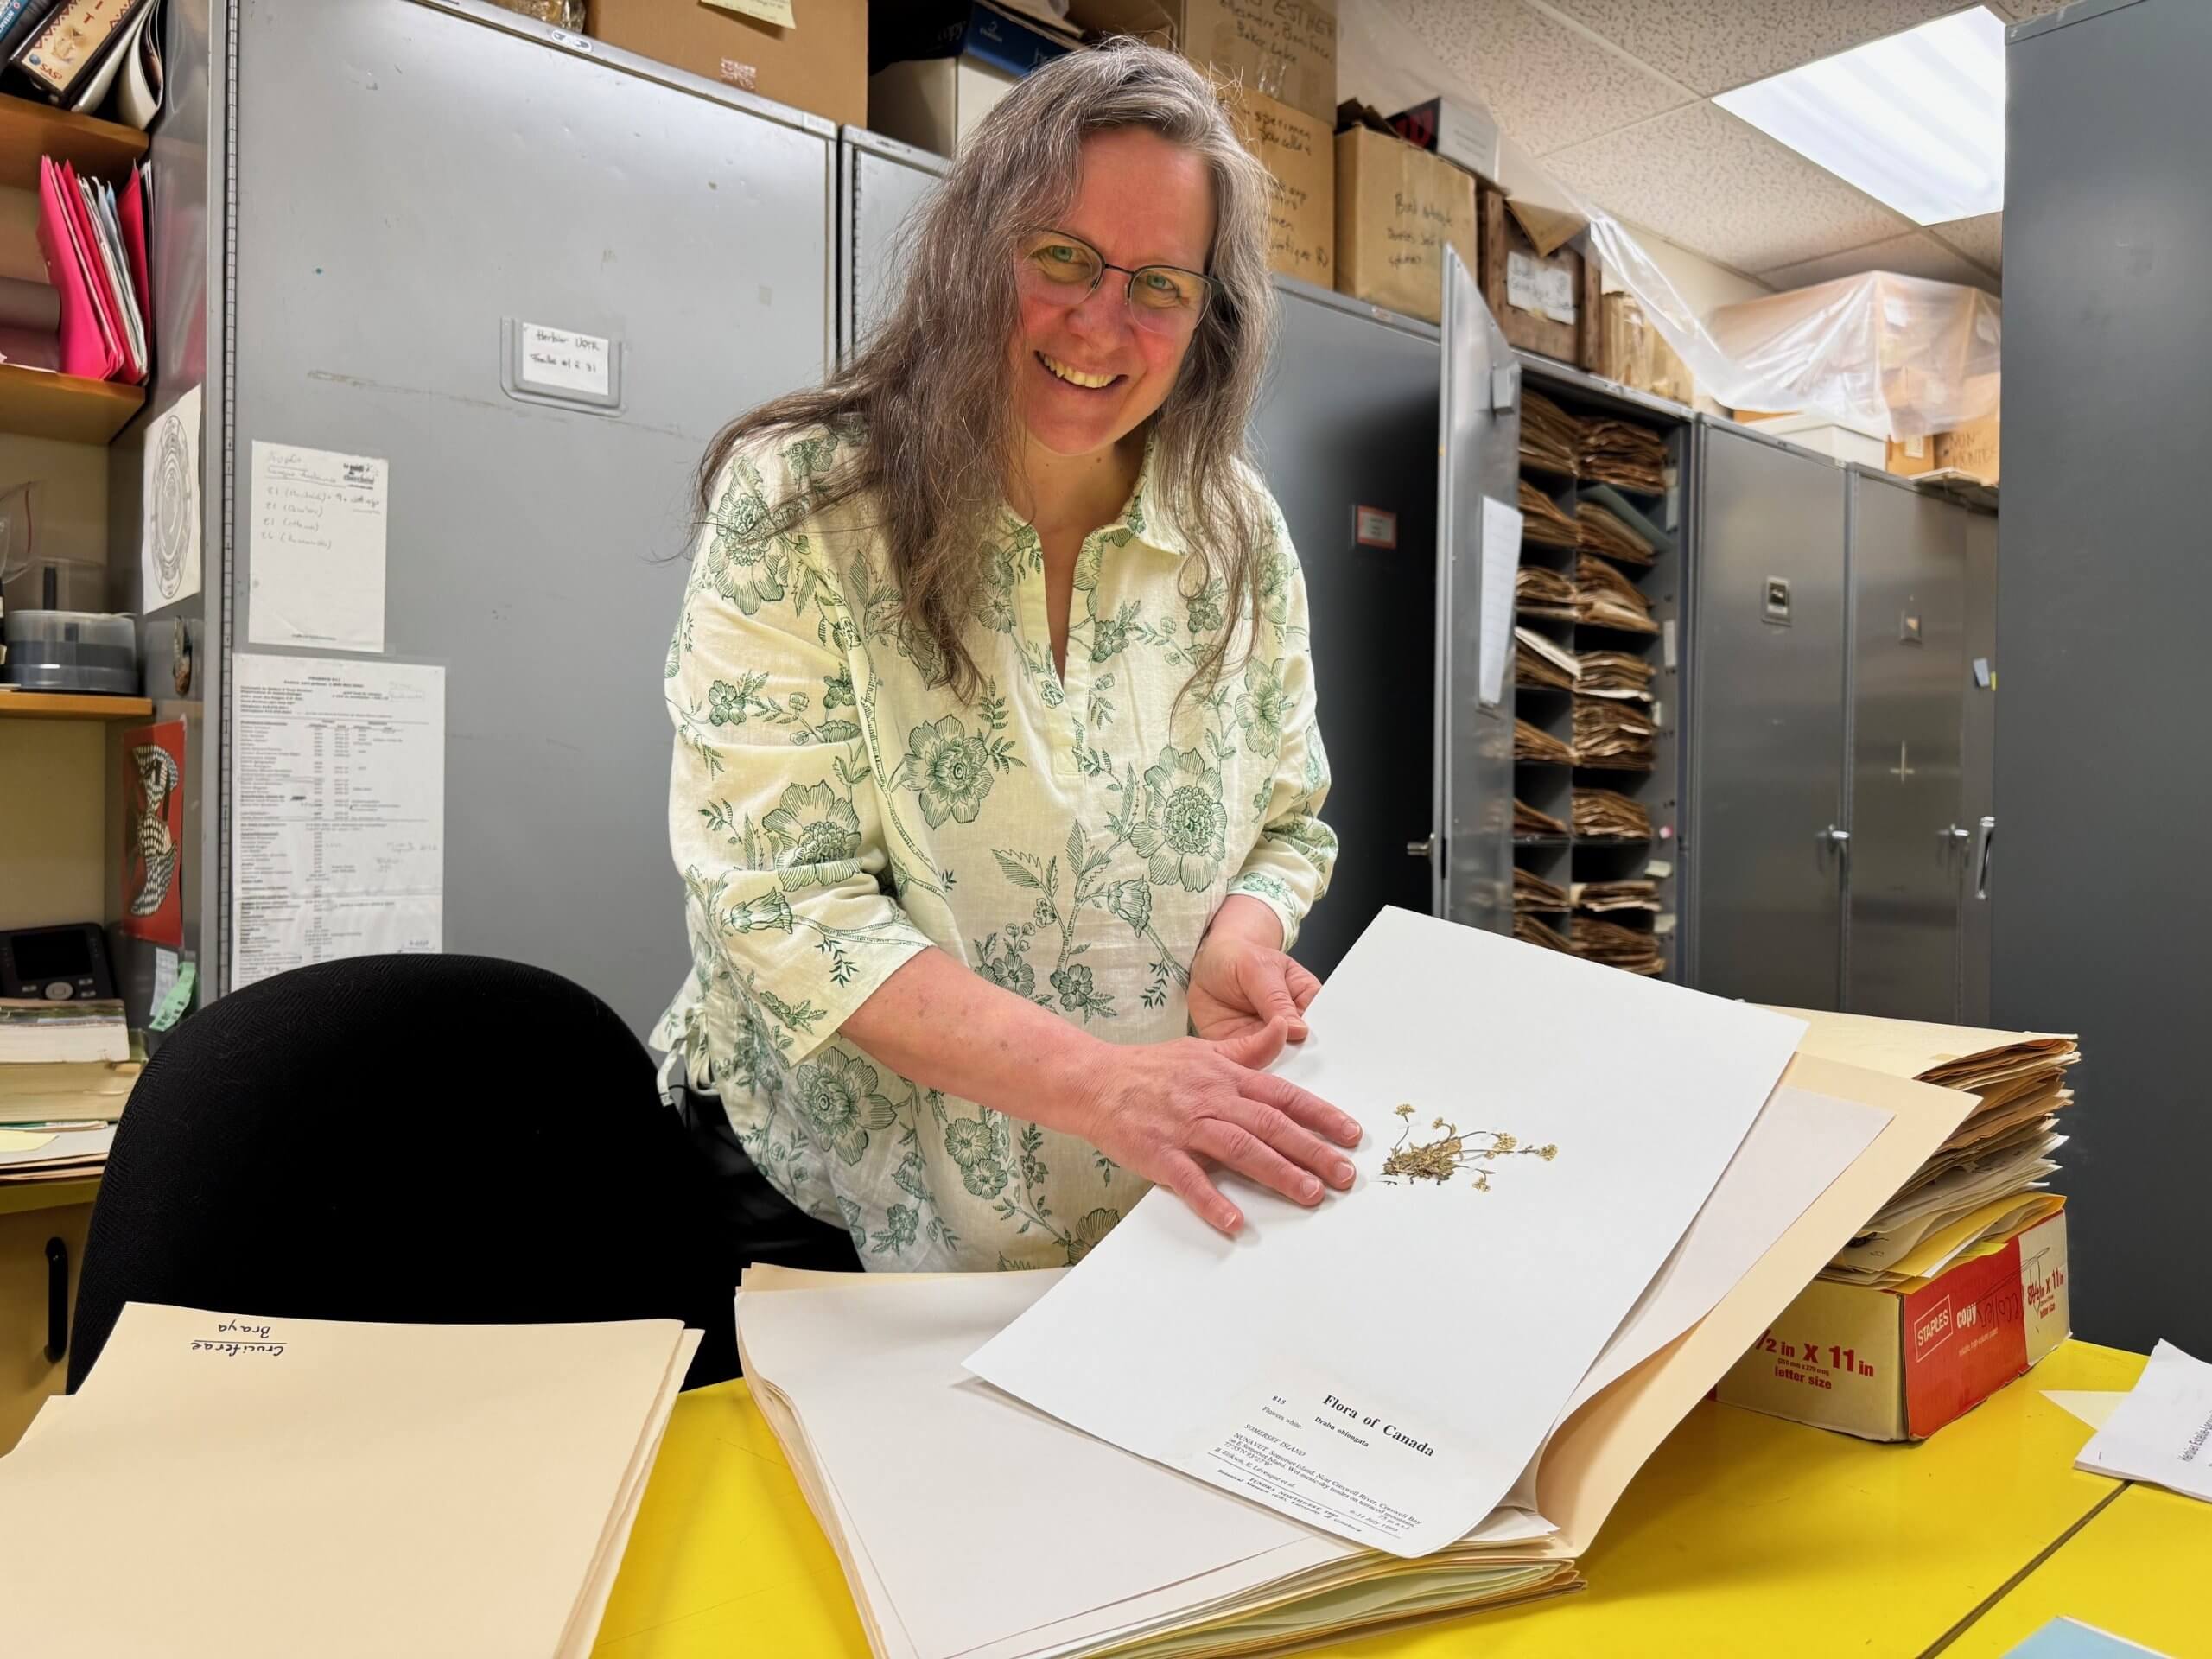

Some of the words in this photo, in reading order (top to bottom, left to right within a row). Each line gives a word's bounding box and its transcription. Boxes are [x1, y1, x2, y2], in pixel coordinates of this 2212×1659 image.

[218, 1319, 271, 1339] Braya
[1917, 1309, 1950, 1347] STAPLES
[1956, 1302, 1977, 1329] copy
[190, 1341, 284, 1357] Cruciferae
[1781, 1341, 1796, 1358] in
[1802, 1343, 1819, 1364] X
[1828, 1345, 1855, 1373] 11
[1859, 1360, 1874, 1377] in
[1775, 1365, 1805, 1382] letter
[1808, 1376, 1832, 1390] size
[1262, 1406, 1285, 1421] Flowers
[1322, 1395, 1358, 1419] Flora
[1363, 1416, 1381, 1428] of
[1382, 1424, 1434, 1457] Canada
[1243, 1423, 1281, 1444] SOMERSET
[1279, 1440, 1306, 1457] ISLAND
[1314, 1416, 1336, 1431] Draba
[1337, 1428, 1370, 1448] oblongata
[1268, 1450, 1297, 1467] Somerset
